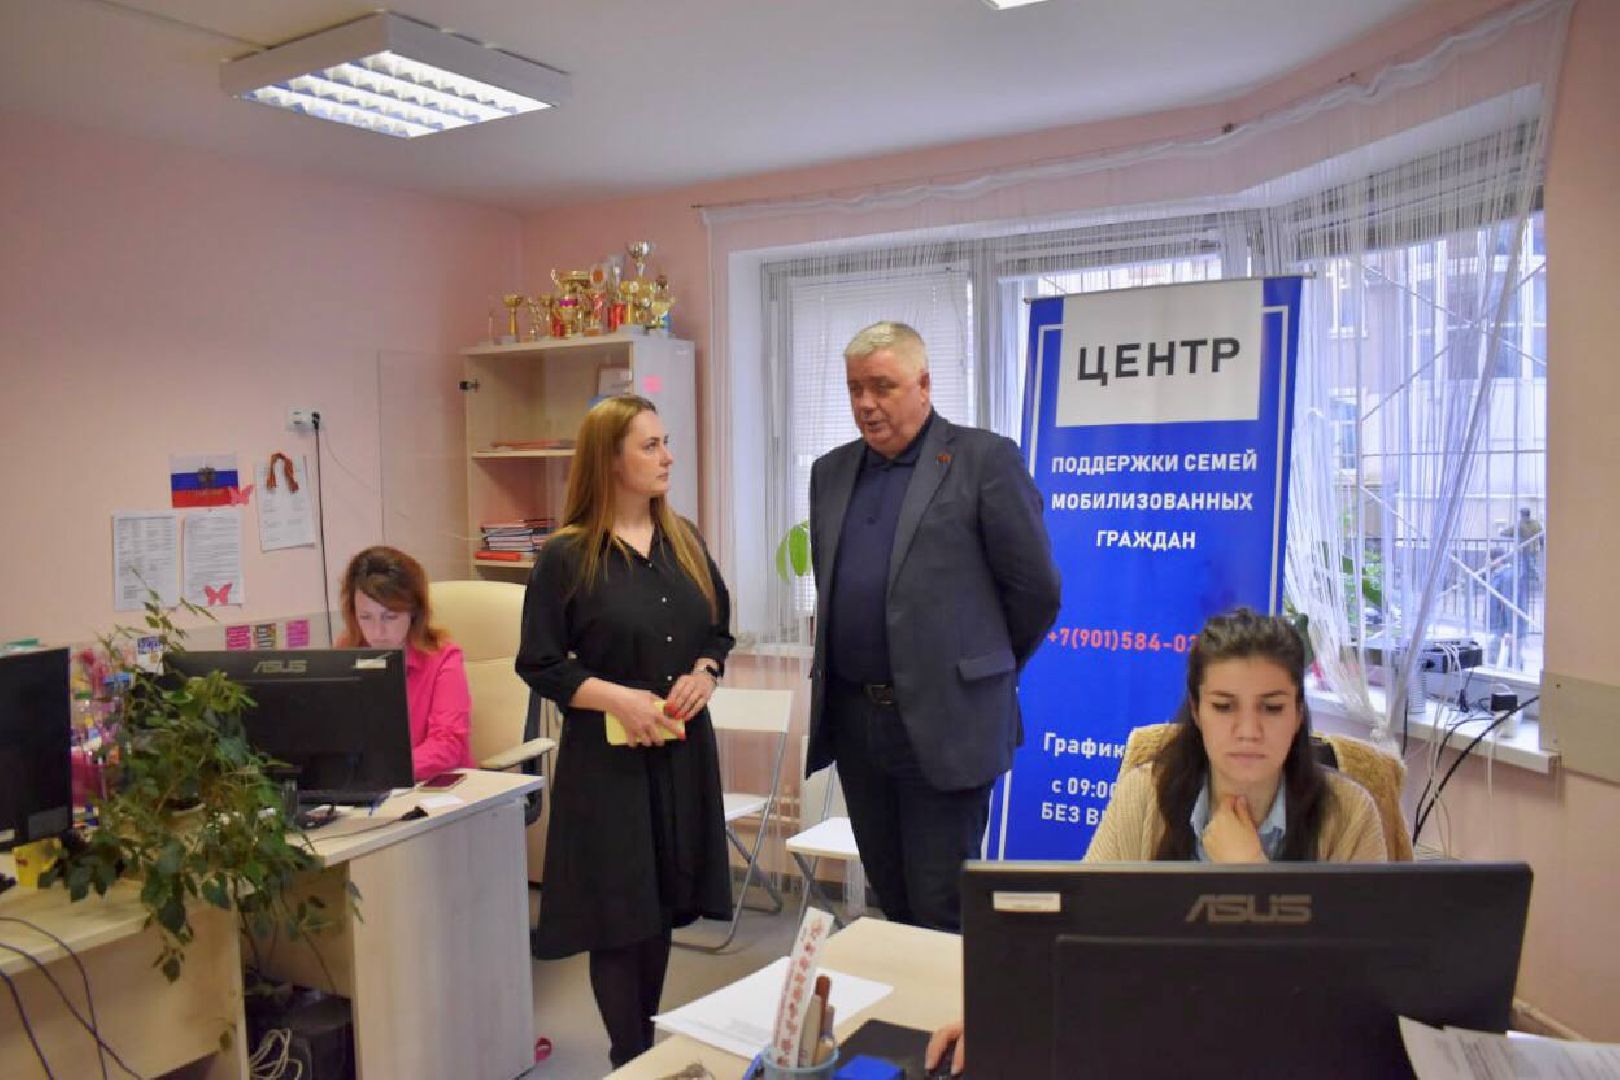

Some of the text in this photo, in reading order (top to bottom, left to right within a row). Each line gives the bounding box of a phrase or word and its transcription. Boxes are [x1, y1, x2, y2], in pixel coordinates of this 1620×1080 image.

[1078, 337, 1240, 386] ЦЕНТР
[1051, 448, 1257, 476] ПОДДЕРЖКИ СЕМЕЙ
[1051, 492, 1253, 511] МОБИЛИЗОВАННЫХ
[1096, 529, 1196, 551] ГРАЖДАН
[252, 659, 307, 673] ASUS
[1043, 732, 1125, 759] График
[1051, 779, 1061, 794] с
[1041, 801, 1107, 826] БЕЗ В
[1187, 894, 1312, 923] ASUS
